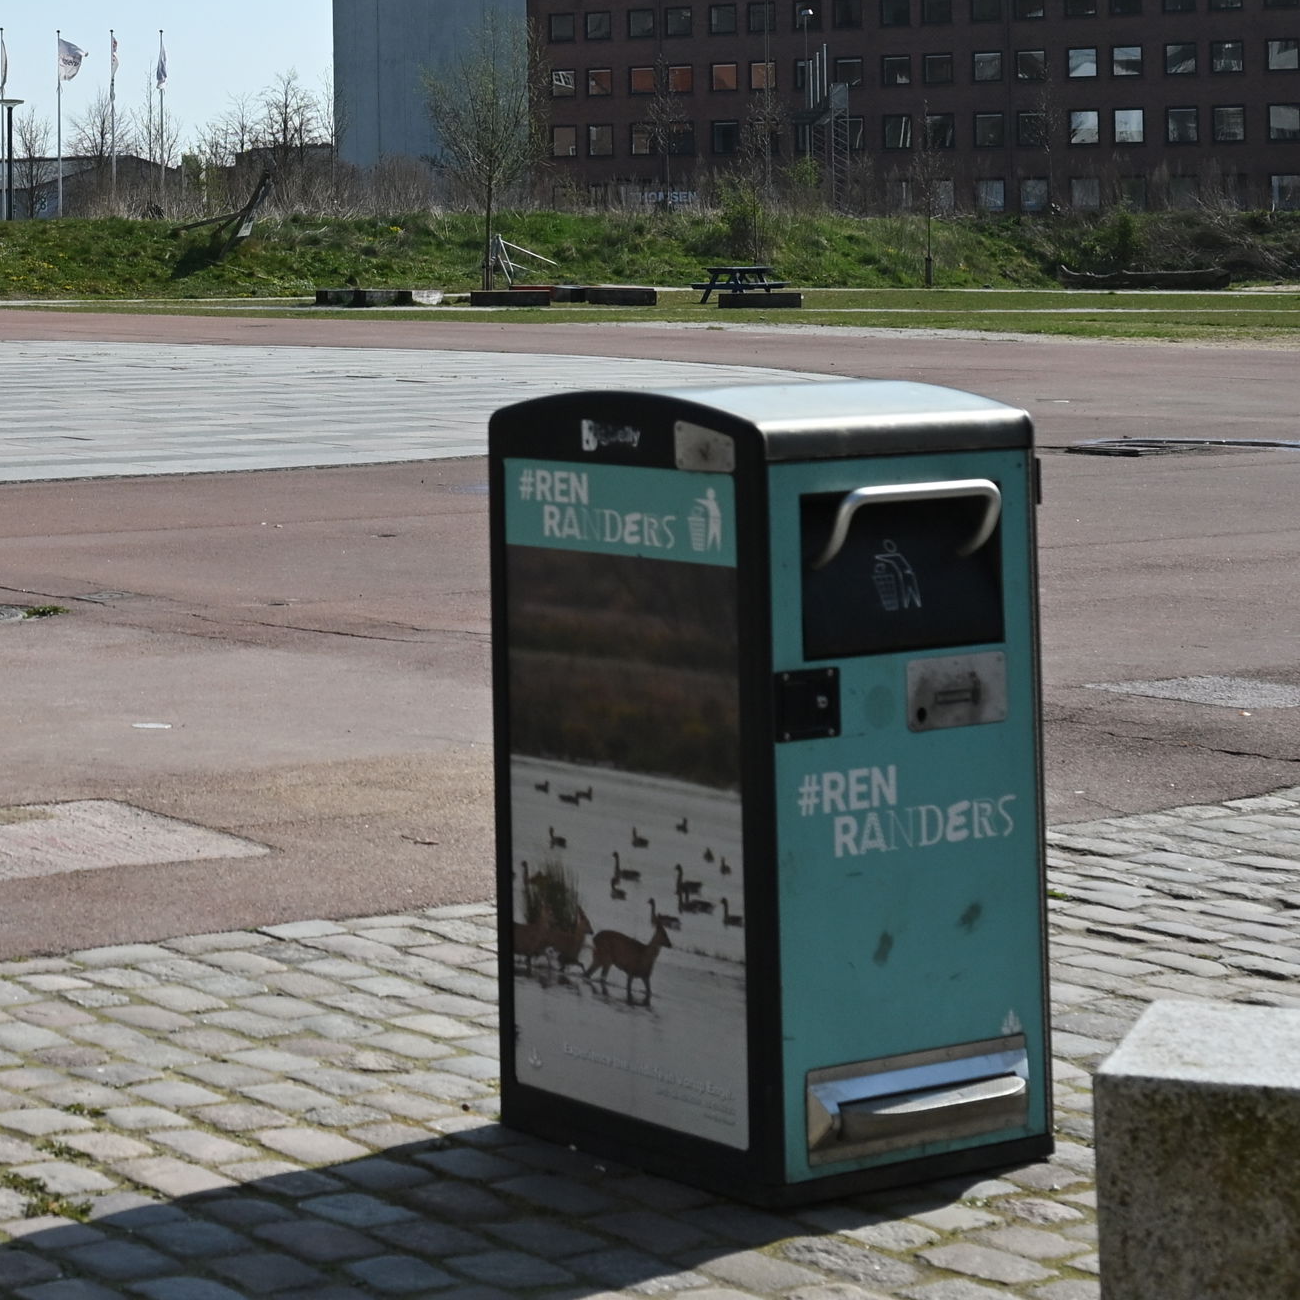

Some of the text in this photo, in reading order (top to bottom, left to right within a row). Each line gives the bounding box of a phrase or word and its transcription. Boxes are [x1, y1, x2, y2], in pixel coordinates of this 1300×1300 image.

[519, 469, 589, 505] #REN
[543, 505, 676, 549] RANDERS
[798, 765, 897, 817] #REN
[834, 794, 1017, 858] RANDERS
